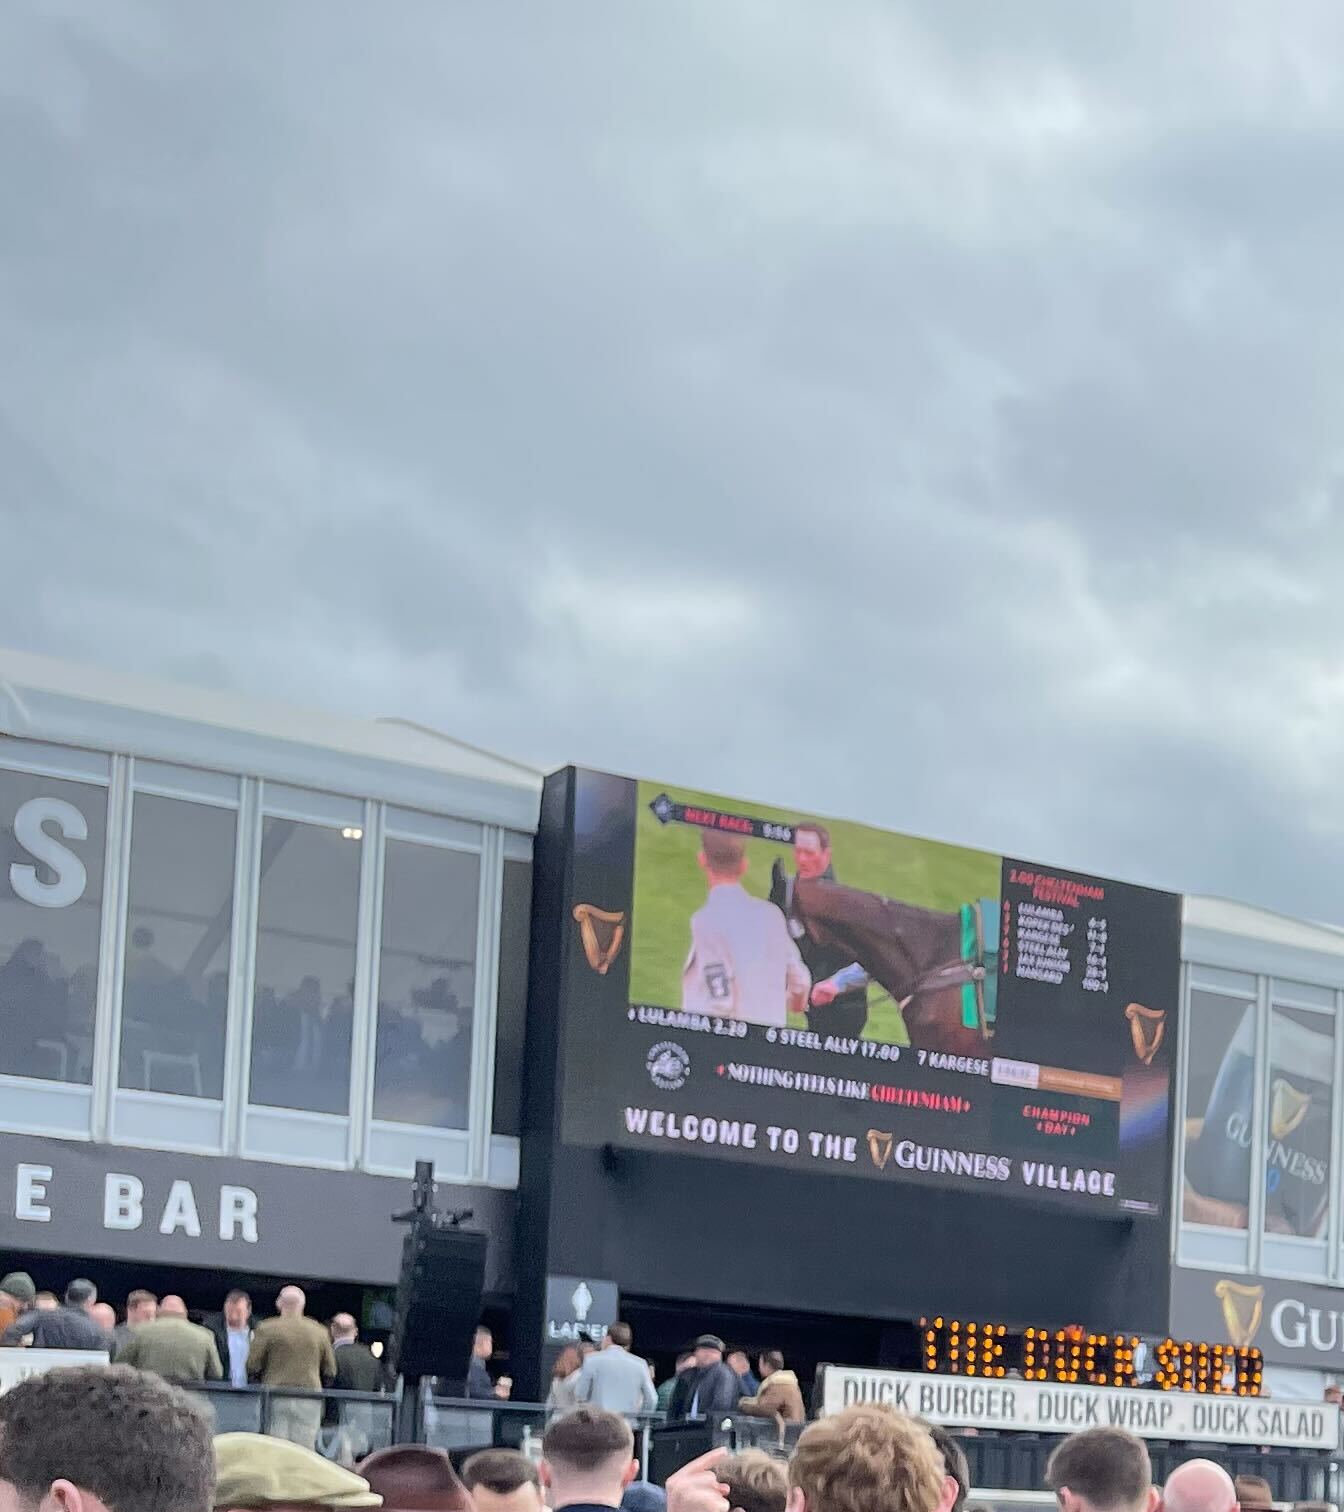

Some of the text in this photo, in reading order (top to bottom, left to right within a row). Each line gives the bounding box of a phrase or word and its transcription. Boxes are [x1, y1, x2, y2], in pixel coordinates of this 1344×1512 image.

[638, 1006, 712, 1033] LULAMBA
[780, 1029, 822, 1050] STEEL
[824, 1035, 859, 1056] ALLY
[917, 1049, 927, 1066] 7
[928, 1052, 990, 1077] KARGESE
[1022, 1104, 1091, 1126] CHAMPION
[625, 1107, 1116, 1197] WELCOME TO THE GUINNESS VILLAGE
[104, 1172, 260, 1243] BAR
[918, 1315, 1264, 1397] THE DUCK SHED
[843, 1375, 1325, 1440] DUCK BURGER DUCK WRAP DUCK SALAD
